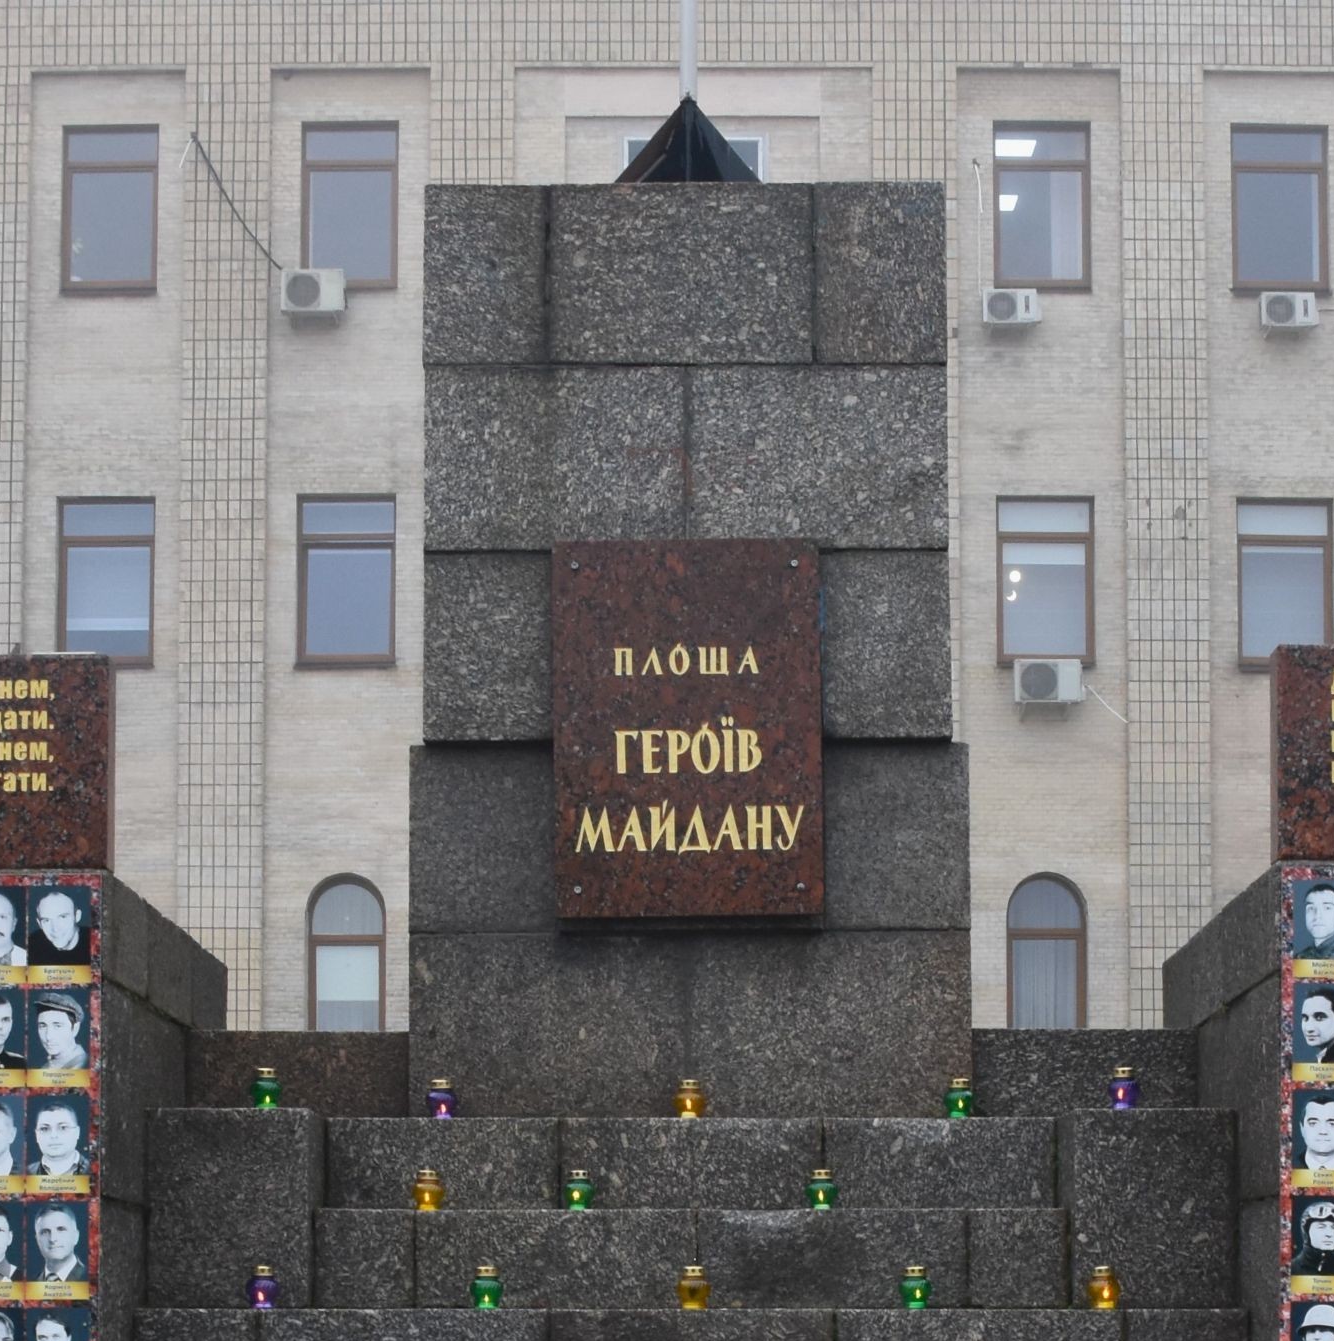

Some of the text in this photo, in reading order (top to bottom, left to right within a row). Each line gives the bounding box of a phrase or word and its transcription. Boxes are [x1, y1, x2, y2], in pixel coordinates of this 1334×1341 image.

[614, 643, 758, 675] ПЛОЩА
[615, 716, 763, 774] ГЕРОЇВ
[576, 800, 804, 852] МАЙДАНУ
